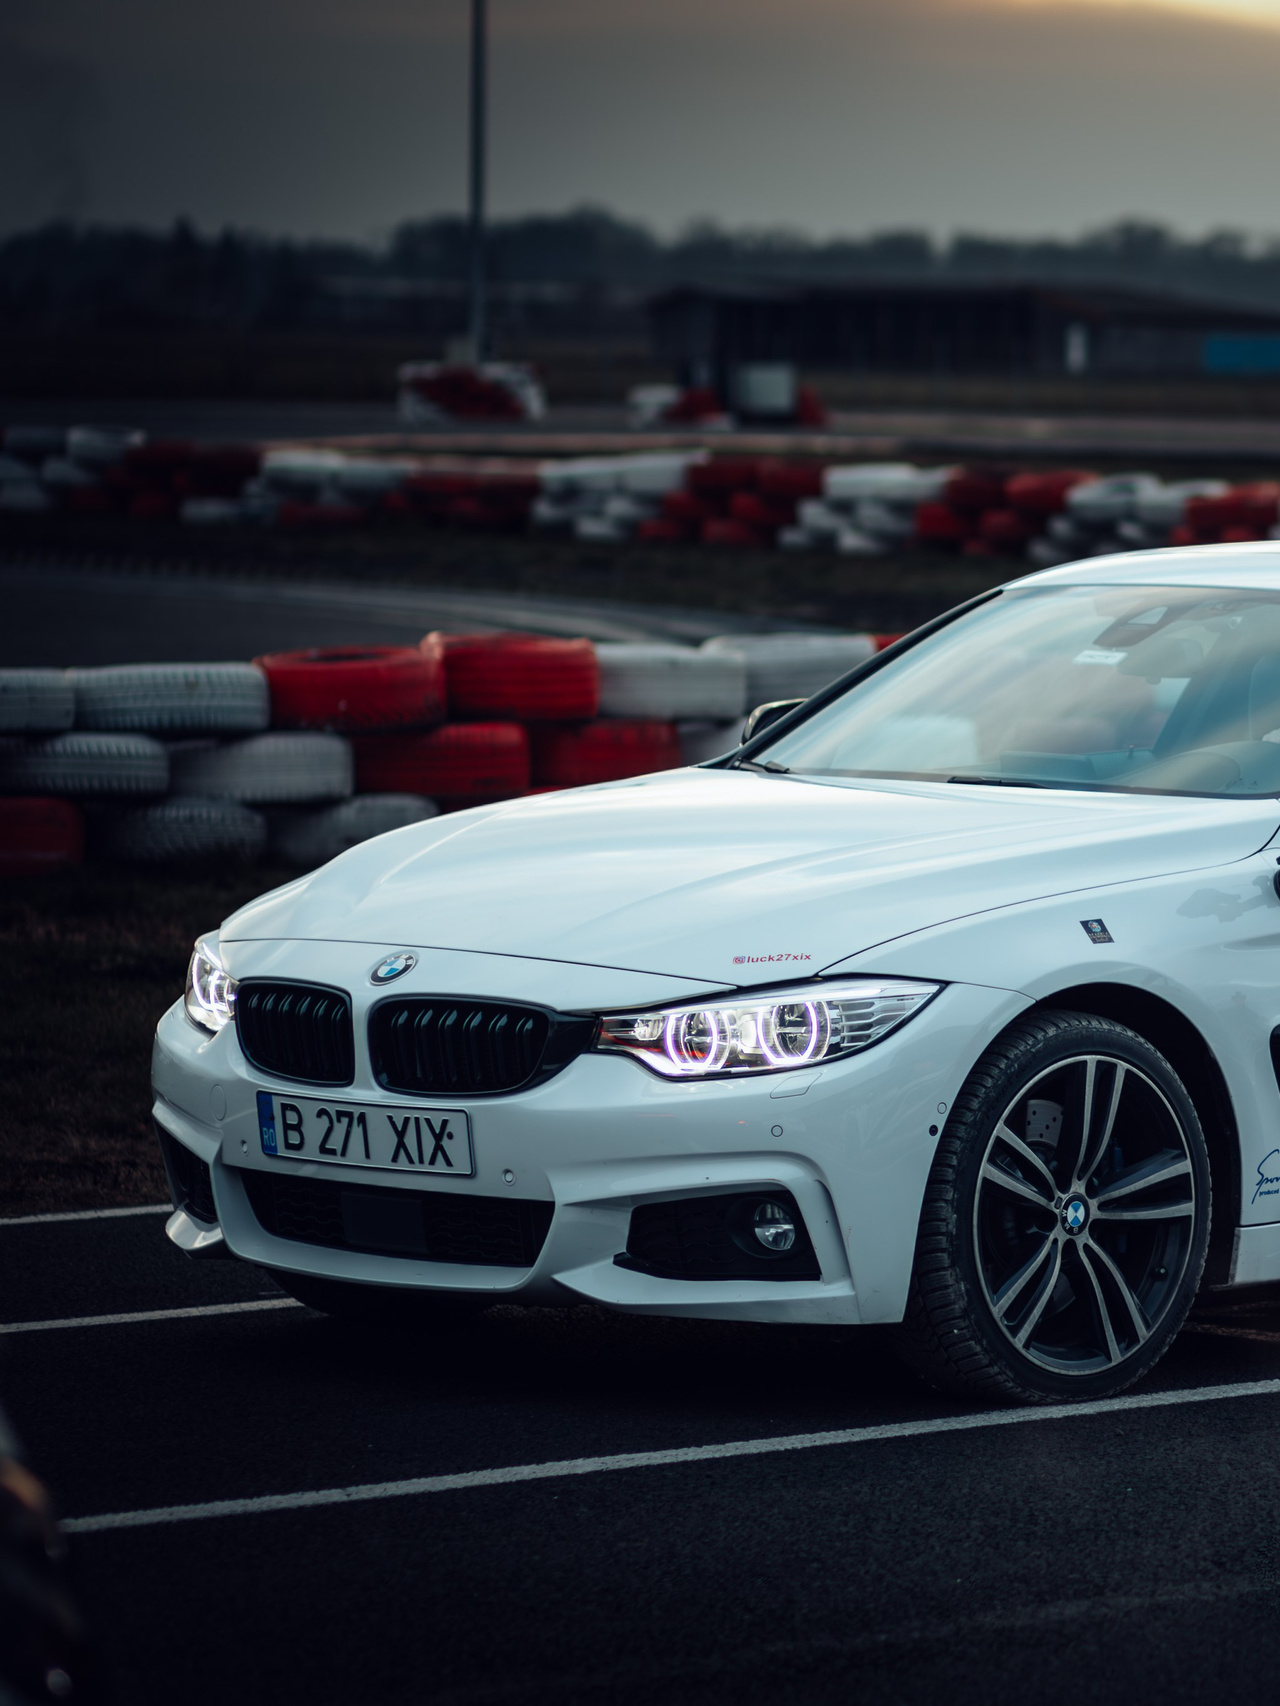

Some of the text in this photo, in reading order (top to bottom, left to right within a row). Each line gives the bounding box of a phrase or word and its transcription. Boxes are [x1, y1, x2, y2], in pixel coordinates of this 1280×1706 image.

[746, 952, 812, 964] luck27xix
[262, 1127, 276, 1147] RO
[280, 1102, 454, 1168] B 271 XIX
[1259, 1188, 1280, 1197] produced
